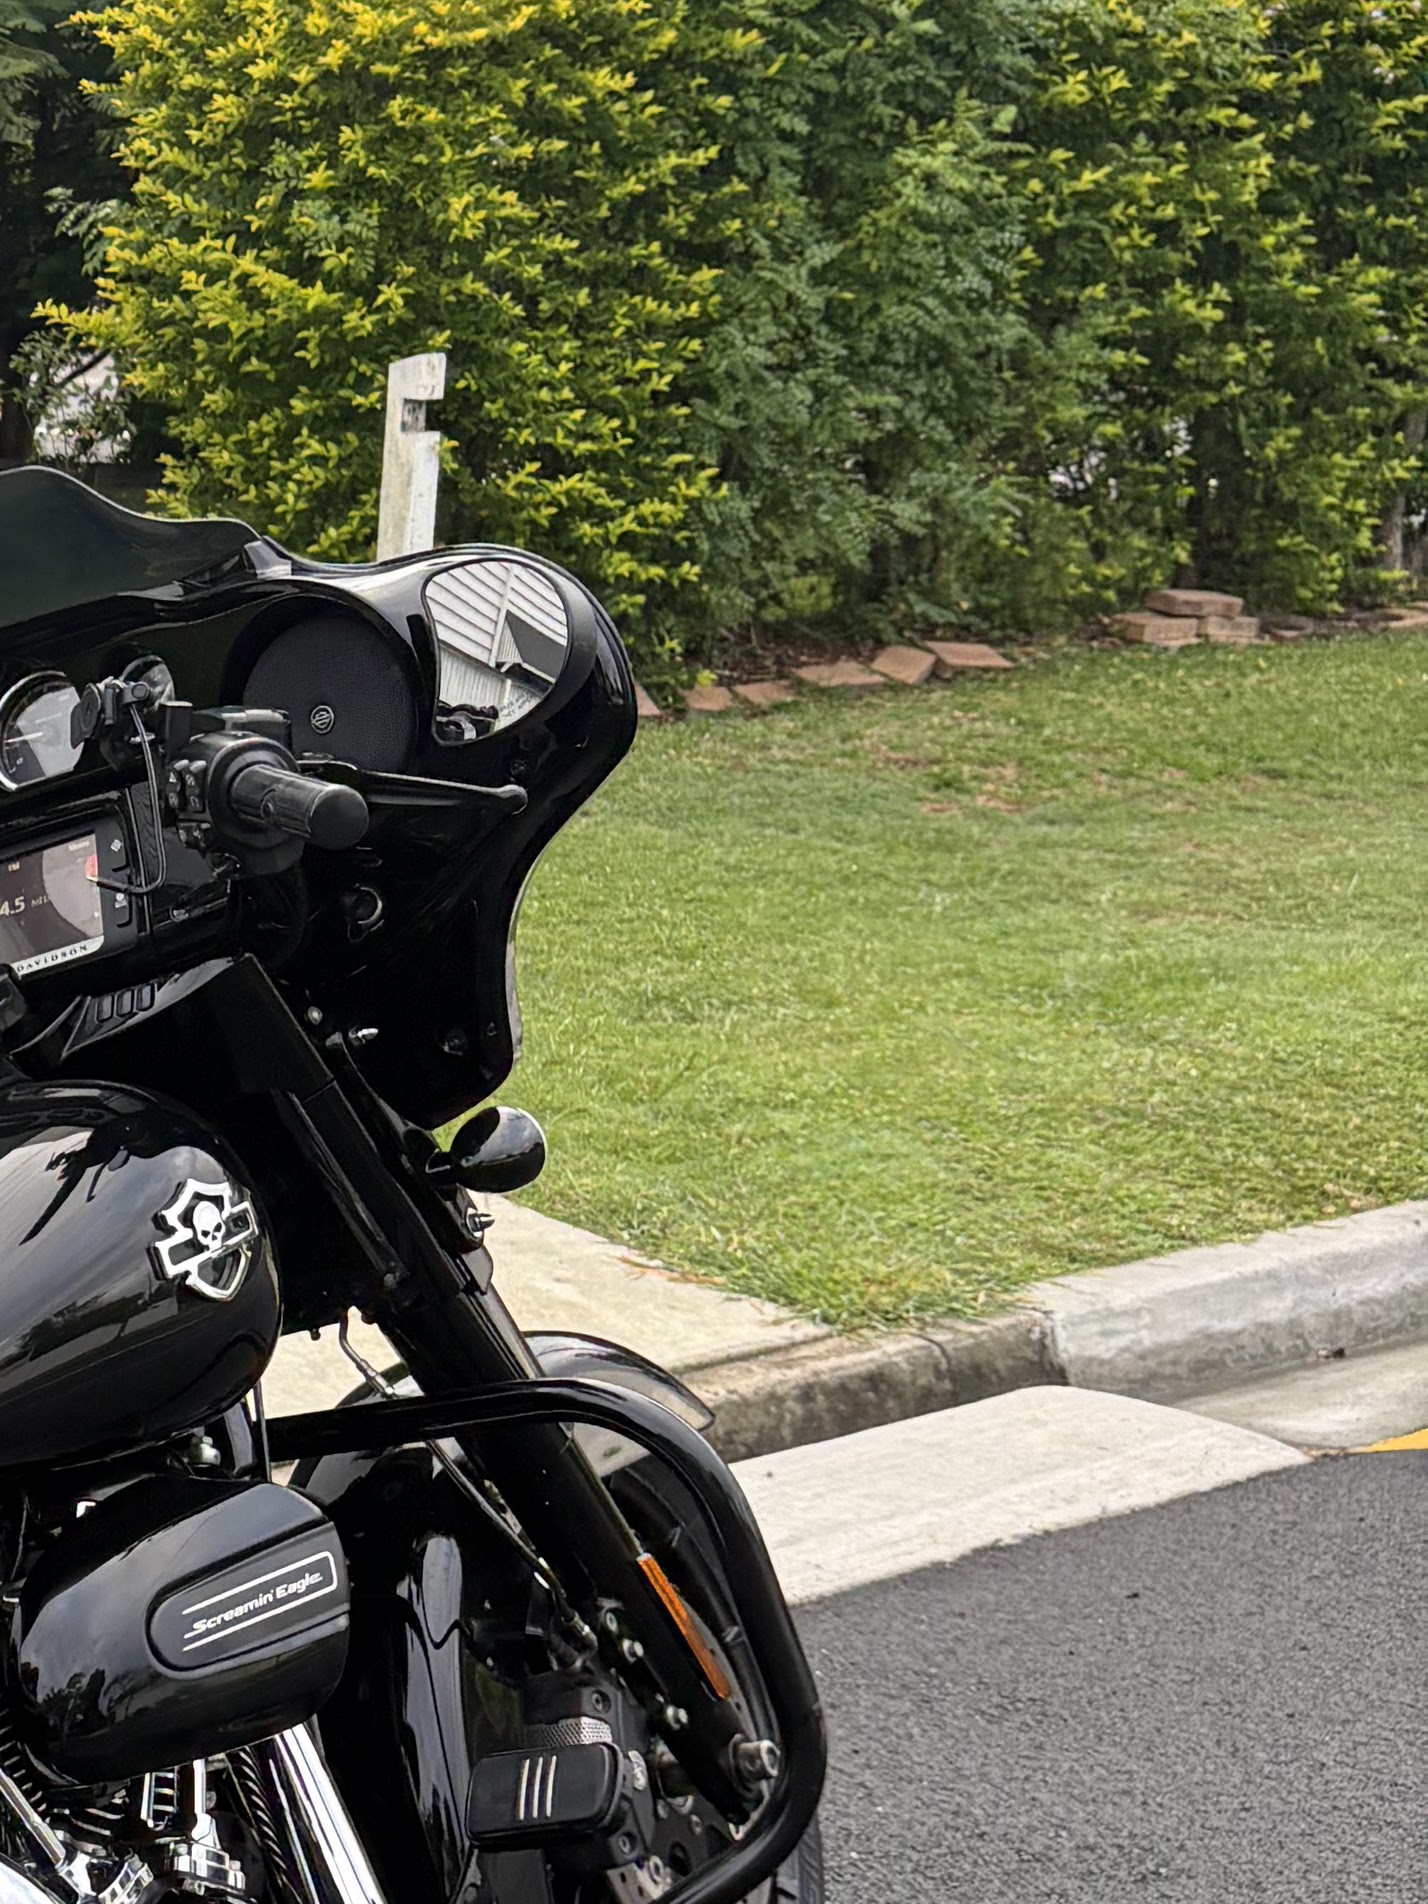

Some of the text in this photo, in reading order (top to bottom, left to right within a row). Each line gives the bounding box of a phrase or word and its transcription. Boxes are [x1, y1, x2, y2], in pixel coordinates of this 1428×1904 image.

[16, 943, 88, 974] DAVIDSON
[184, 1572, 323, 1639] Screamin' Eagle
